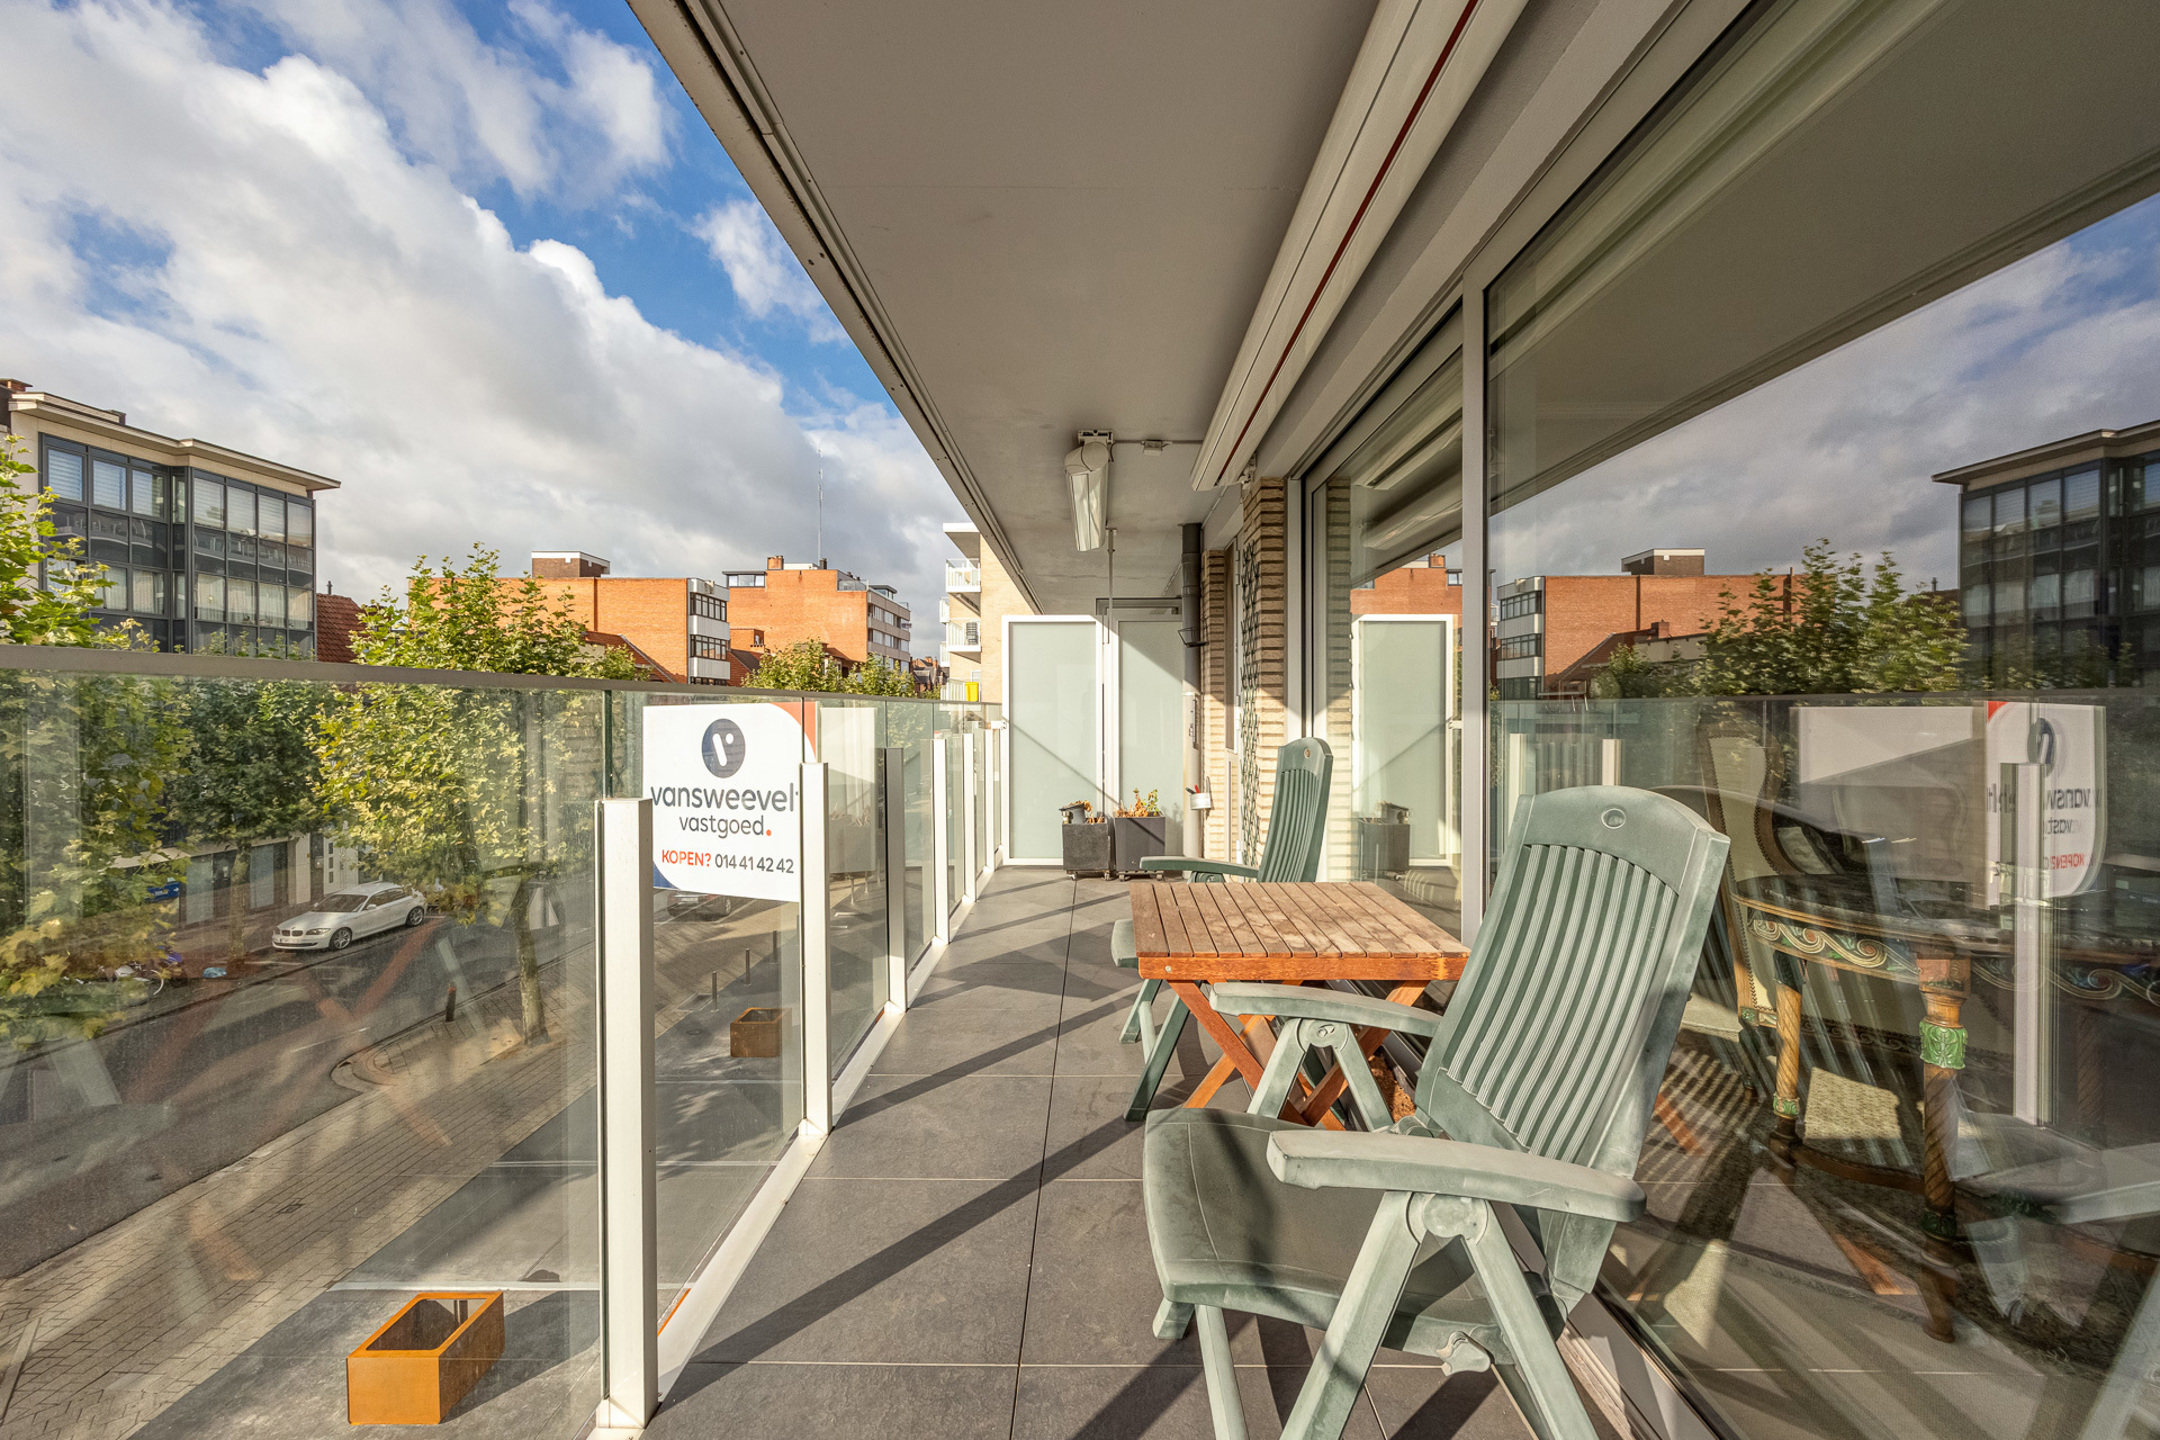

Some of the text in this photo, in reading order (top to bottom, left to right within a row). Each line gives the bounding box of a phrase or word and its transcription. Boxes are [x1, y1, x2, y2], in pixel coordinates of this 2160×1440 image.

[650, 782, 799, 812] vansweevel
[679, 815, 772, 839] vastgoed.
[661, 849, 712, 867] KOPEN?
